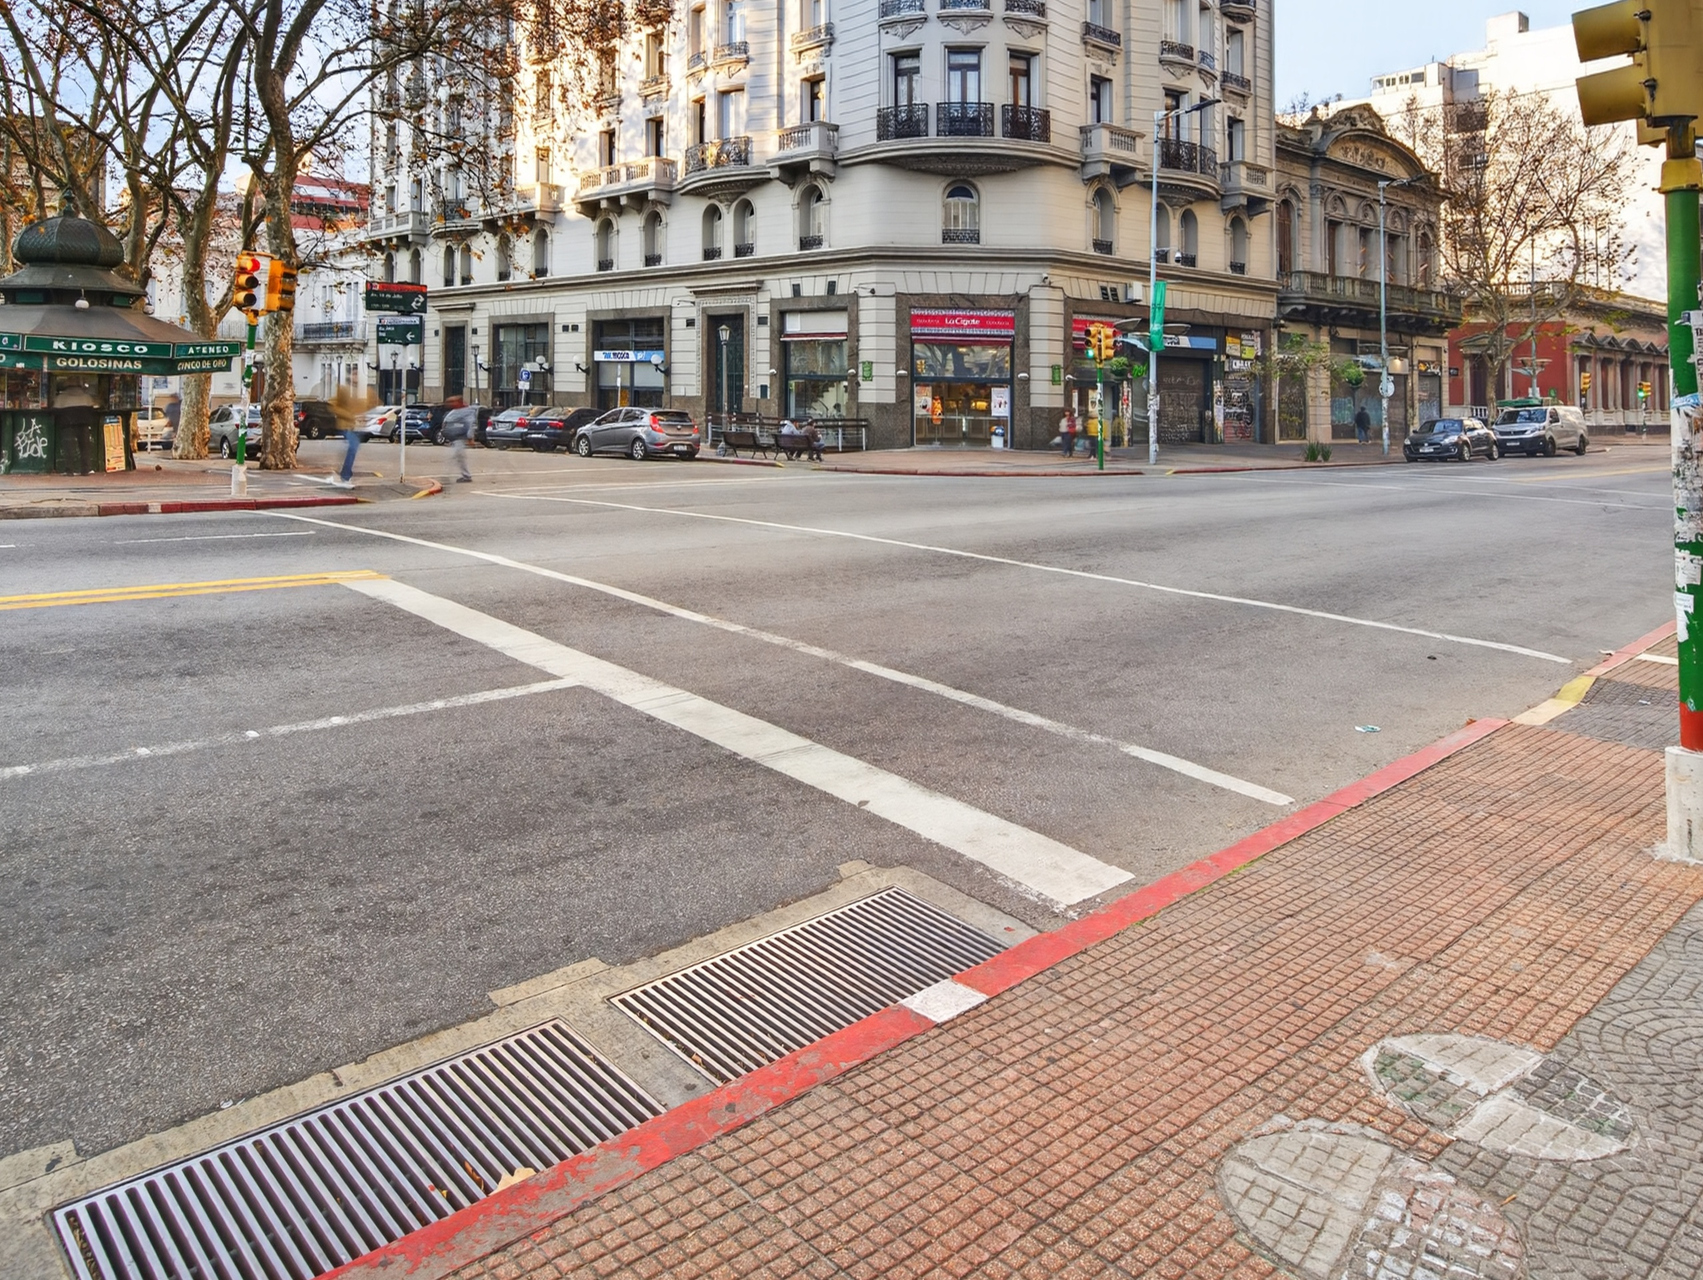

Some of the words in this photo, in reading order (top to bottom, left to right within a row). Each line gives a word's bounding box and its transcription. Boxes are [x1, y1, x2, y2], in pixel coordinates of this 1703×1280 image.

[52, 341, 148, 354] KIOSCO
[187, 345, 229, 355] ATENEO
[56, 357, 142, 370] GOLOSINAS
[177, 361, 201, 371] CINCO
[201, 360, 211, 369] DE
[212, 359, 227, 368] ORO
